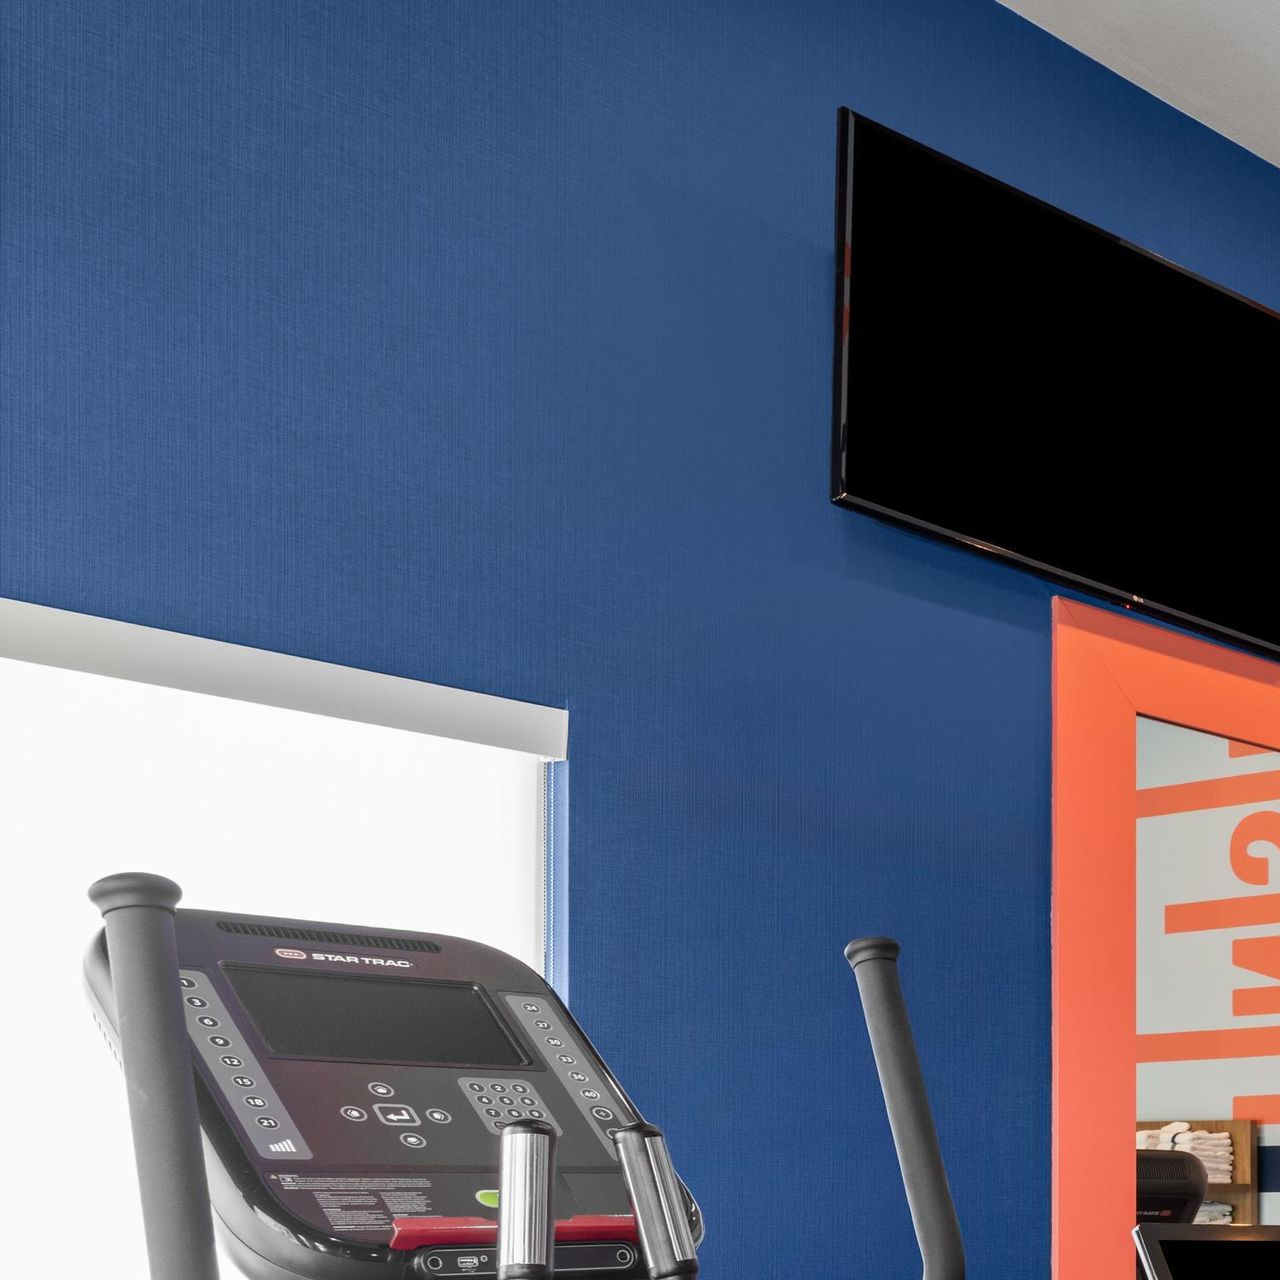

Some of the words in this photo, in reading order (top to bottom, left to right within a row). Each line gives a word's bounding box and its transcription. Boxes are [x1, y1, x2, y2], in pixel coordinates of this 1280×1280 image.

[312, 953, 359, 963] STAR
[360, 957, 411, 967] TRAC
[224, 1057, 240, 1066] 12
[236, 1078, 251, 1086] 15
[247, 1098, 263, 1106] 18
[259, 1118, 275, 1127] 21
